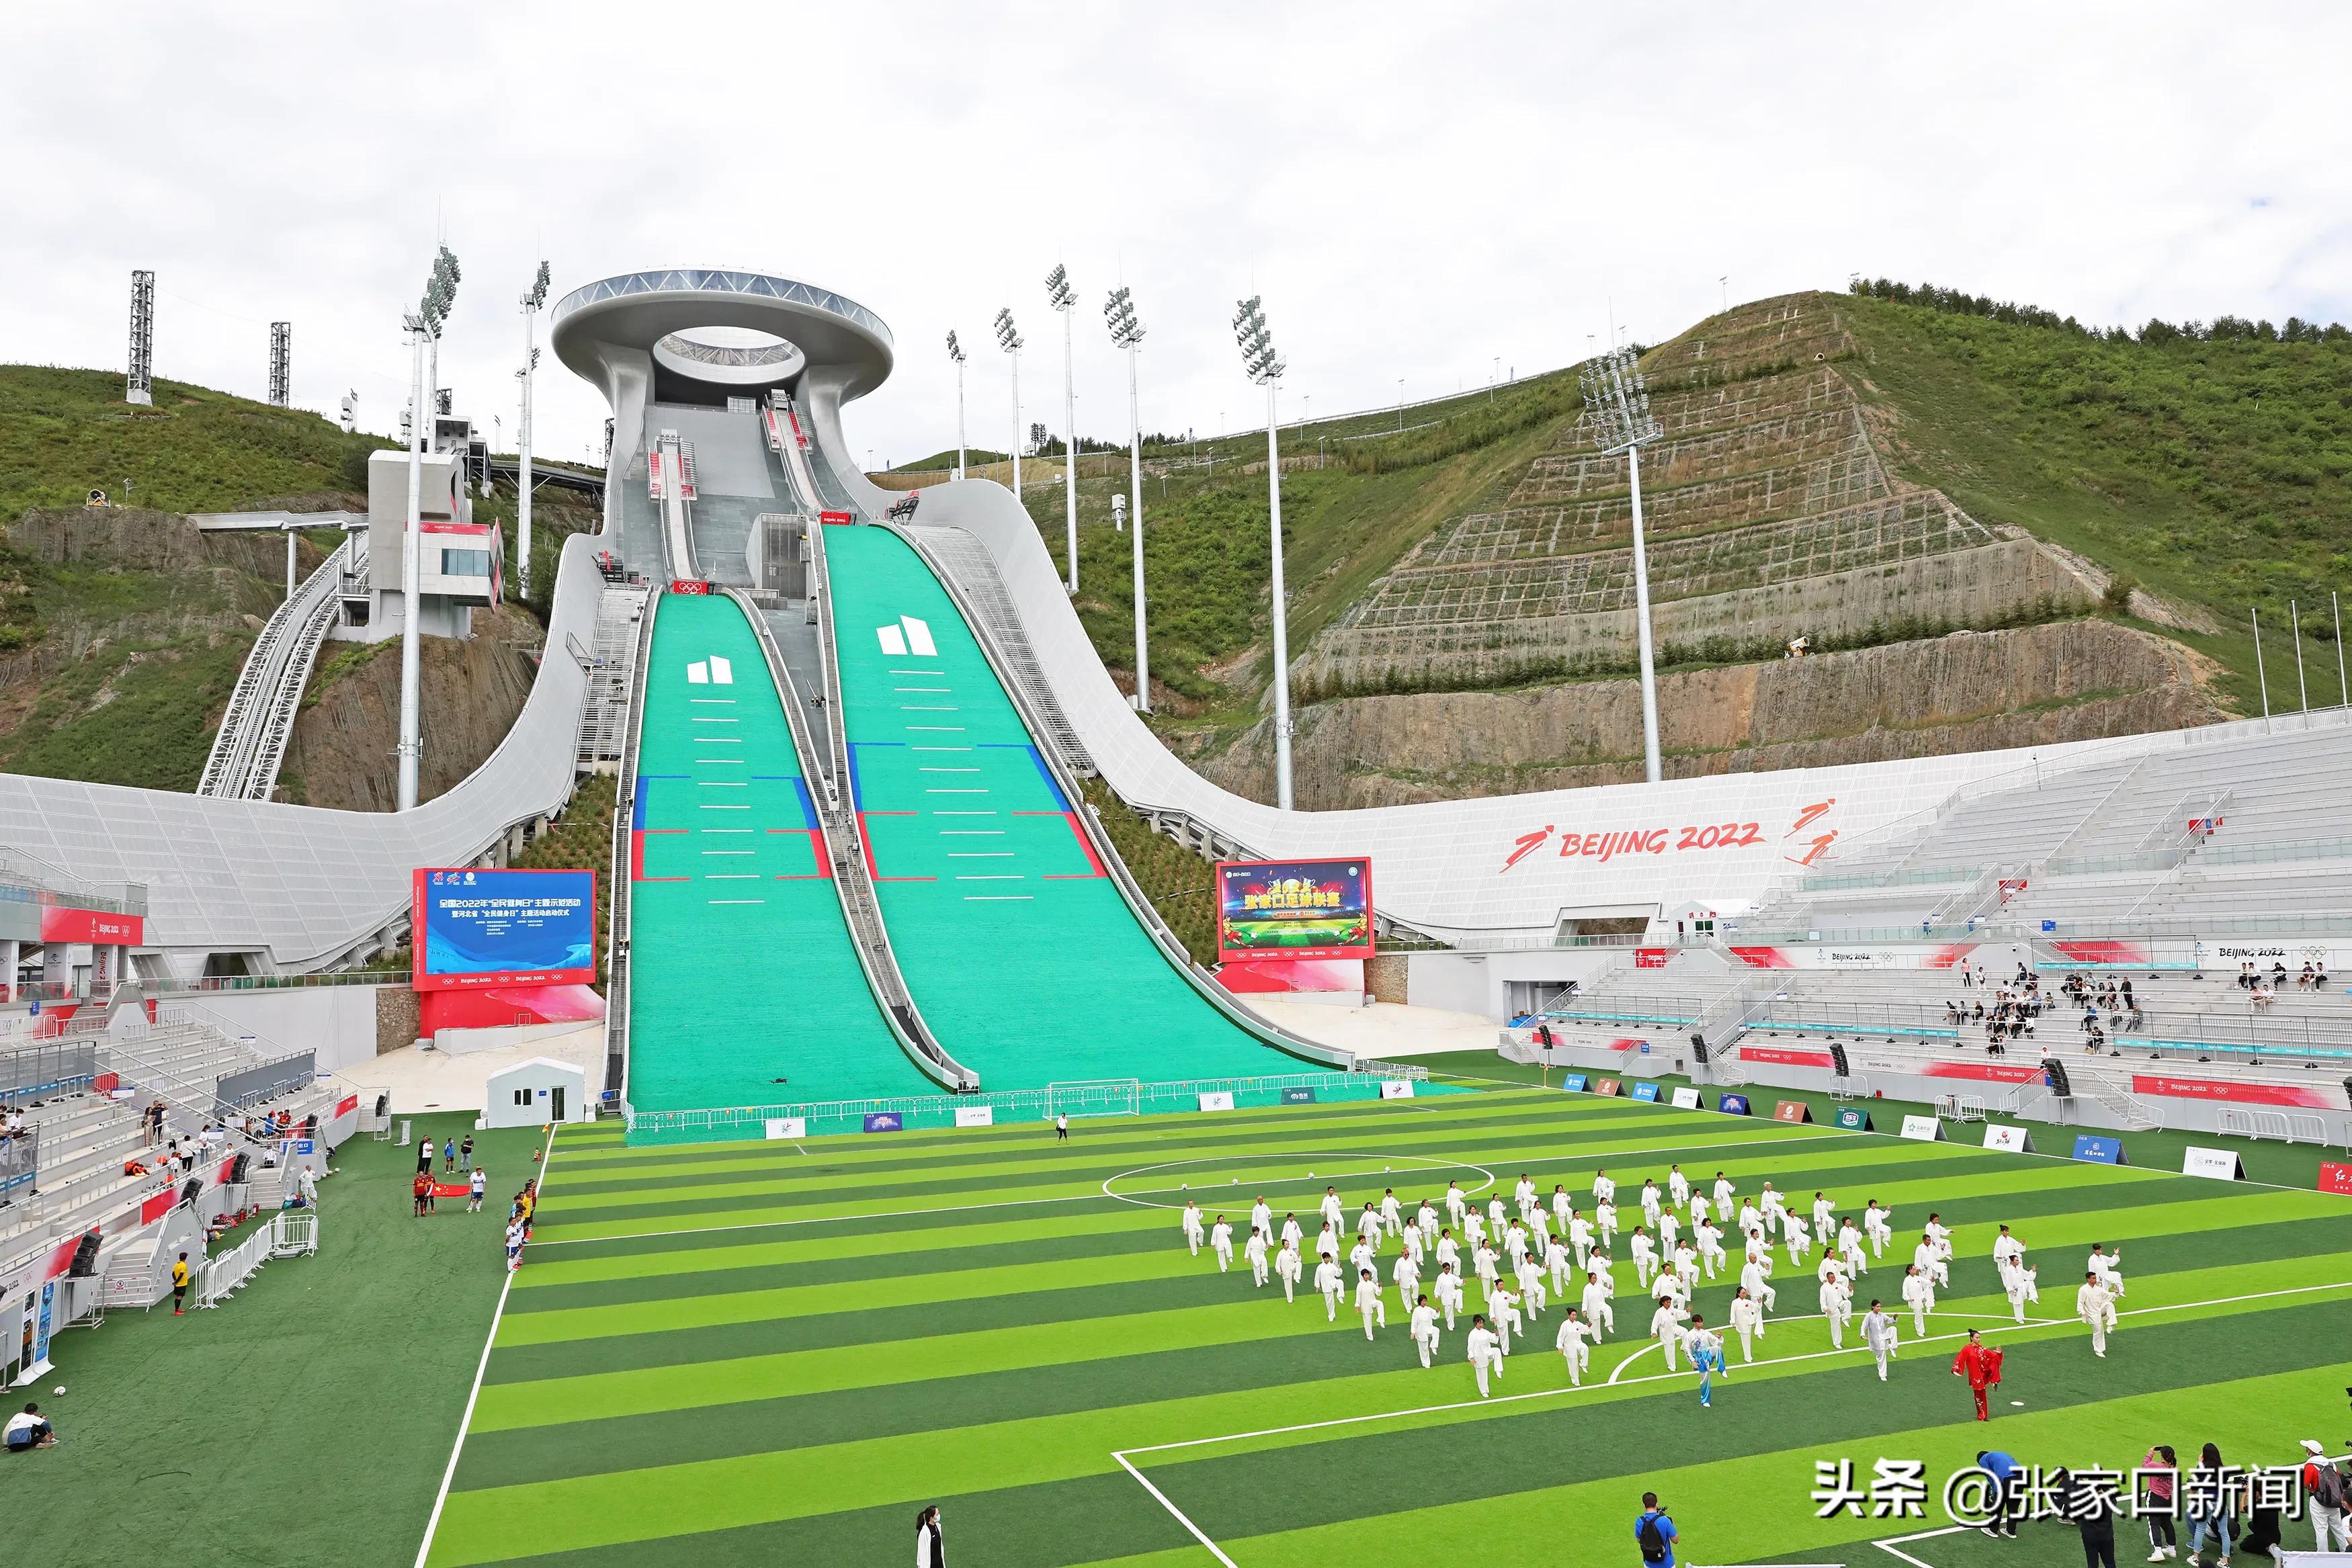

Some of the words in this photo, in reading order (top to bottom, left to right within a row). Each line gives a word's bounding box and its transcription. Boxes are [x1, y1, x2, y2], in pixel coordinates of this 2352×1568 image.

[1560, 828, 1669, 862] BEIJING
[1676, 823, 1767, 851] 2022
[1244, 891, 1340, 909] 张家口足球联赛
[1832, 953, 1853, 962] BEIJING
[2218, 948, 2255, 959] BEIJING
[2257, 947, 2287, 957] 2022
[99, 951, 108, 974] BEIJING
